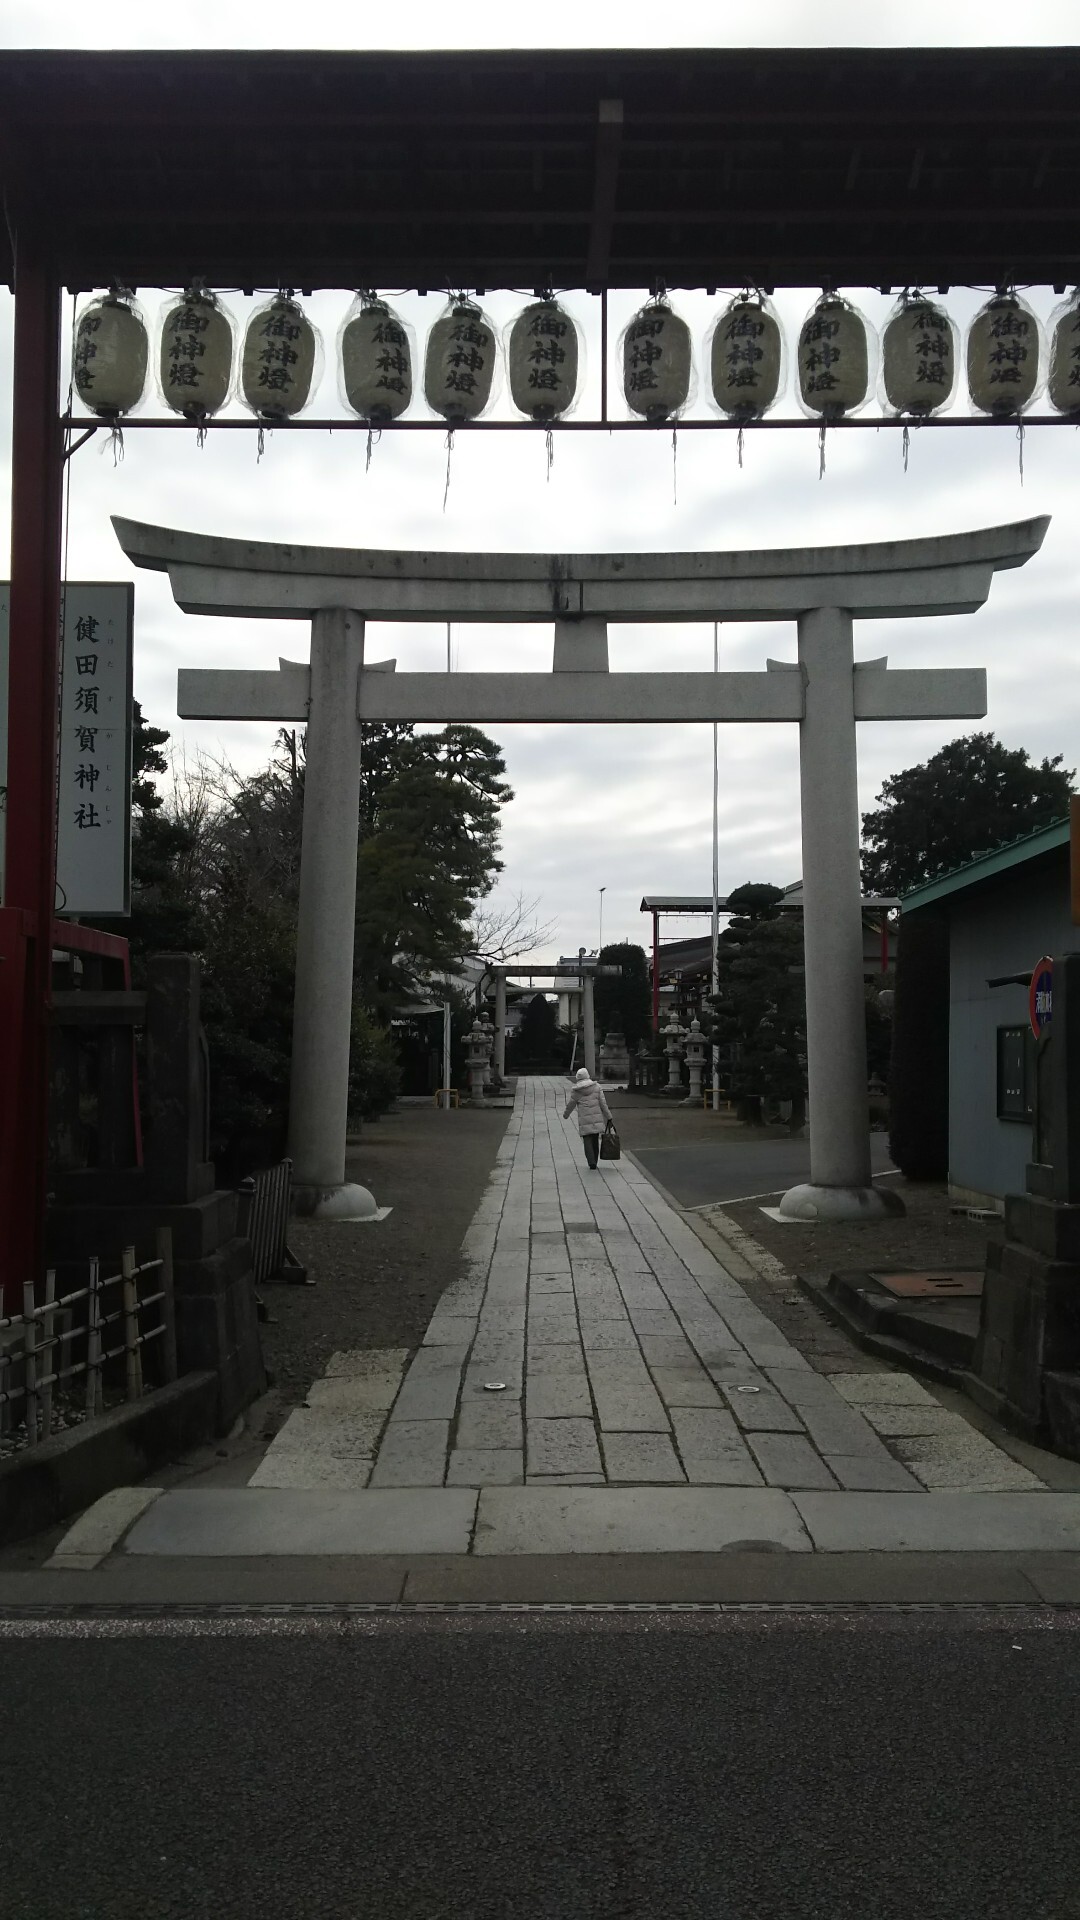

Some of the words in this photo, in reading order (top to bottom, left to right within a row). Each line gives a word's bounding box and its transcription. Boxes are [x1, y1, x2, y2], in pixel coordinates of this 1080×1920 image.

[168, 308, 210, 387] 御神燈
[257, 314, 302, 393] 御神燈
[371, 322, 408, 395] 御神燈
[444, 323, 488, 396] 御神燈
[527, 314, 568, 390] 御神燈
[628, 318, 664, 391] 御神燈
[725, 313, 764, 388] 御神燈
[803, 317, 840, 393] 御神燈
[912, 313, 950, 385] 御神燈
[989, 312, 1029, 384] 御神燈
[73, 615, 101, 830] 健田須賀神社
